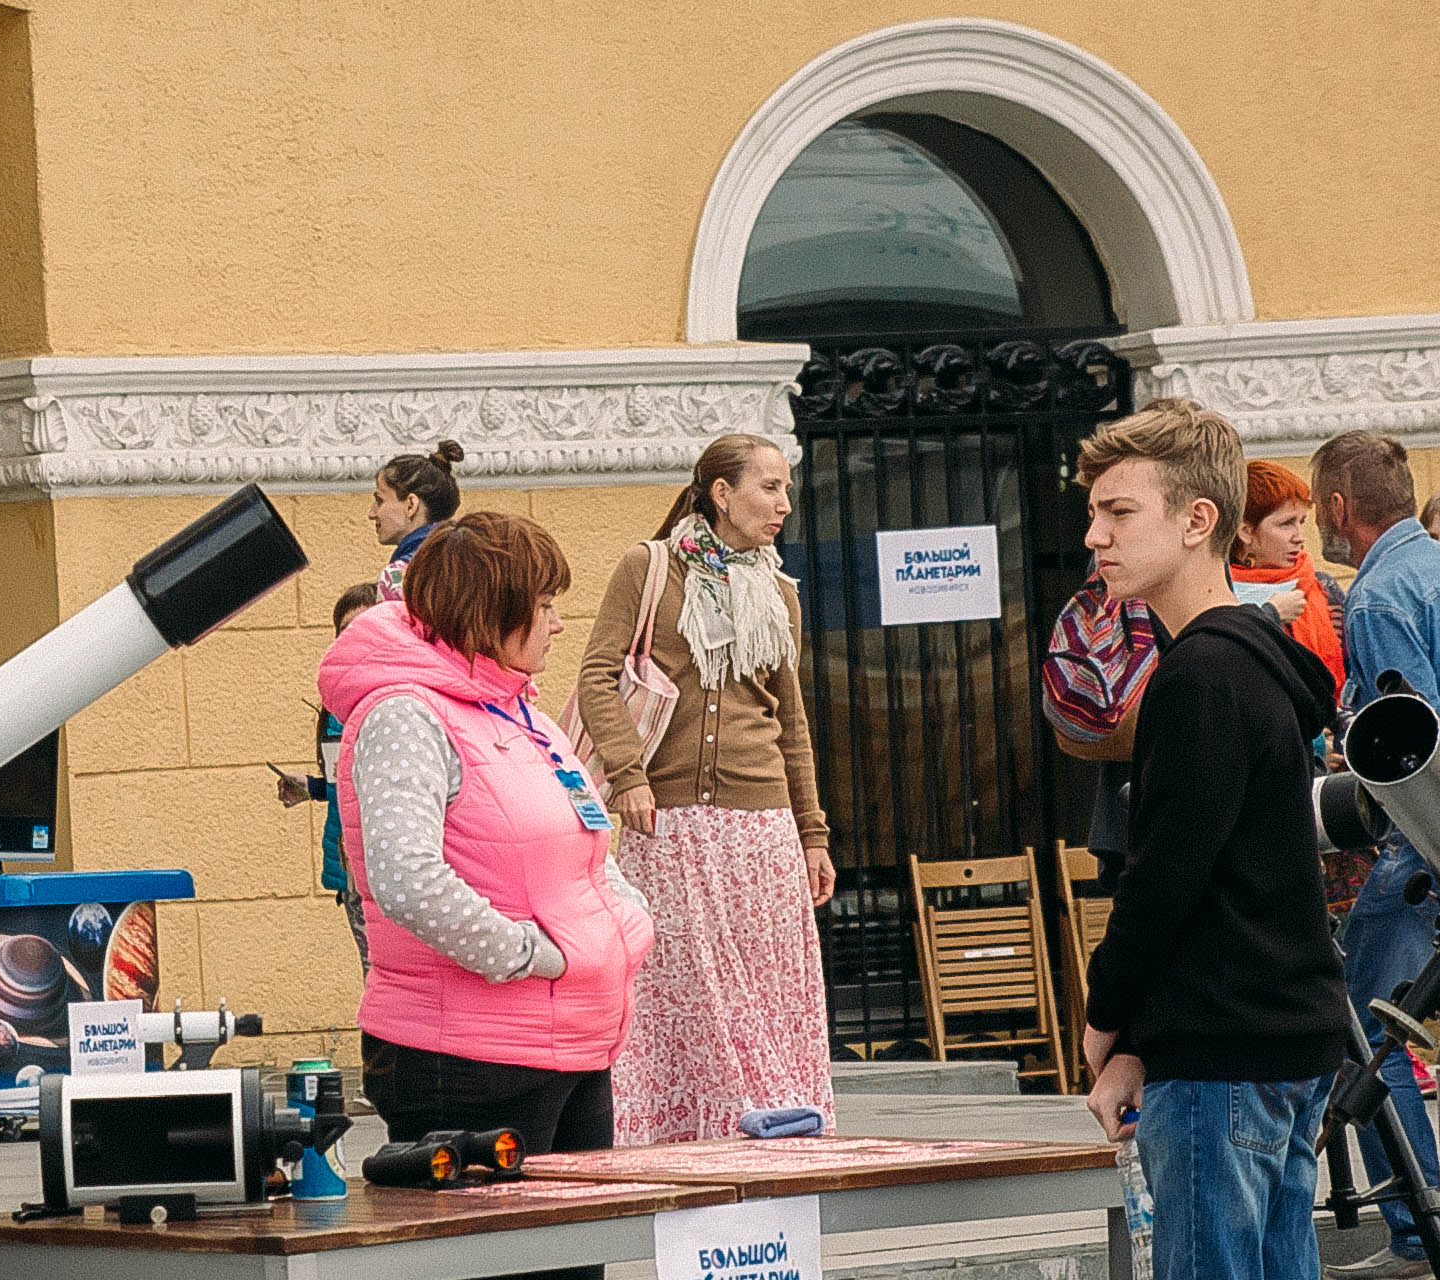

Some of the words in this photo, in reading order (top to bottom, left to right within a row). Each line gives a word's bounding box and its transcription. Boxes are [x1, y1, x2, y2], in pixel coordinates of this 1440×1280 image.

[904, 542, 971, 564] БОЛЬШОЙ
[895, 562, 981, 582] ПЛАНЕТАРИЙ
[84, 1016, 130, 1037] БОЛЬШОЙ
[79, 1036, 137, 1053] ПЛАНЕТАРИЙ
[698, 1232, 788, 1270] БОЛЬШОЙ
